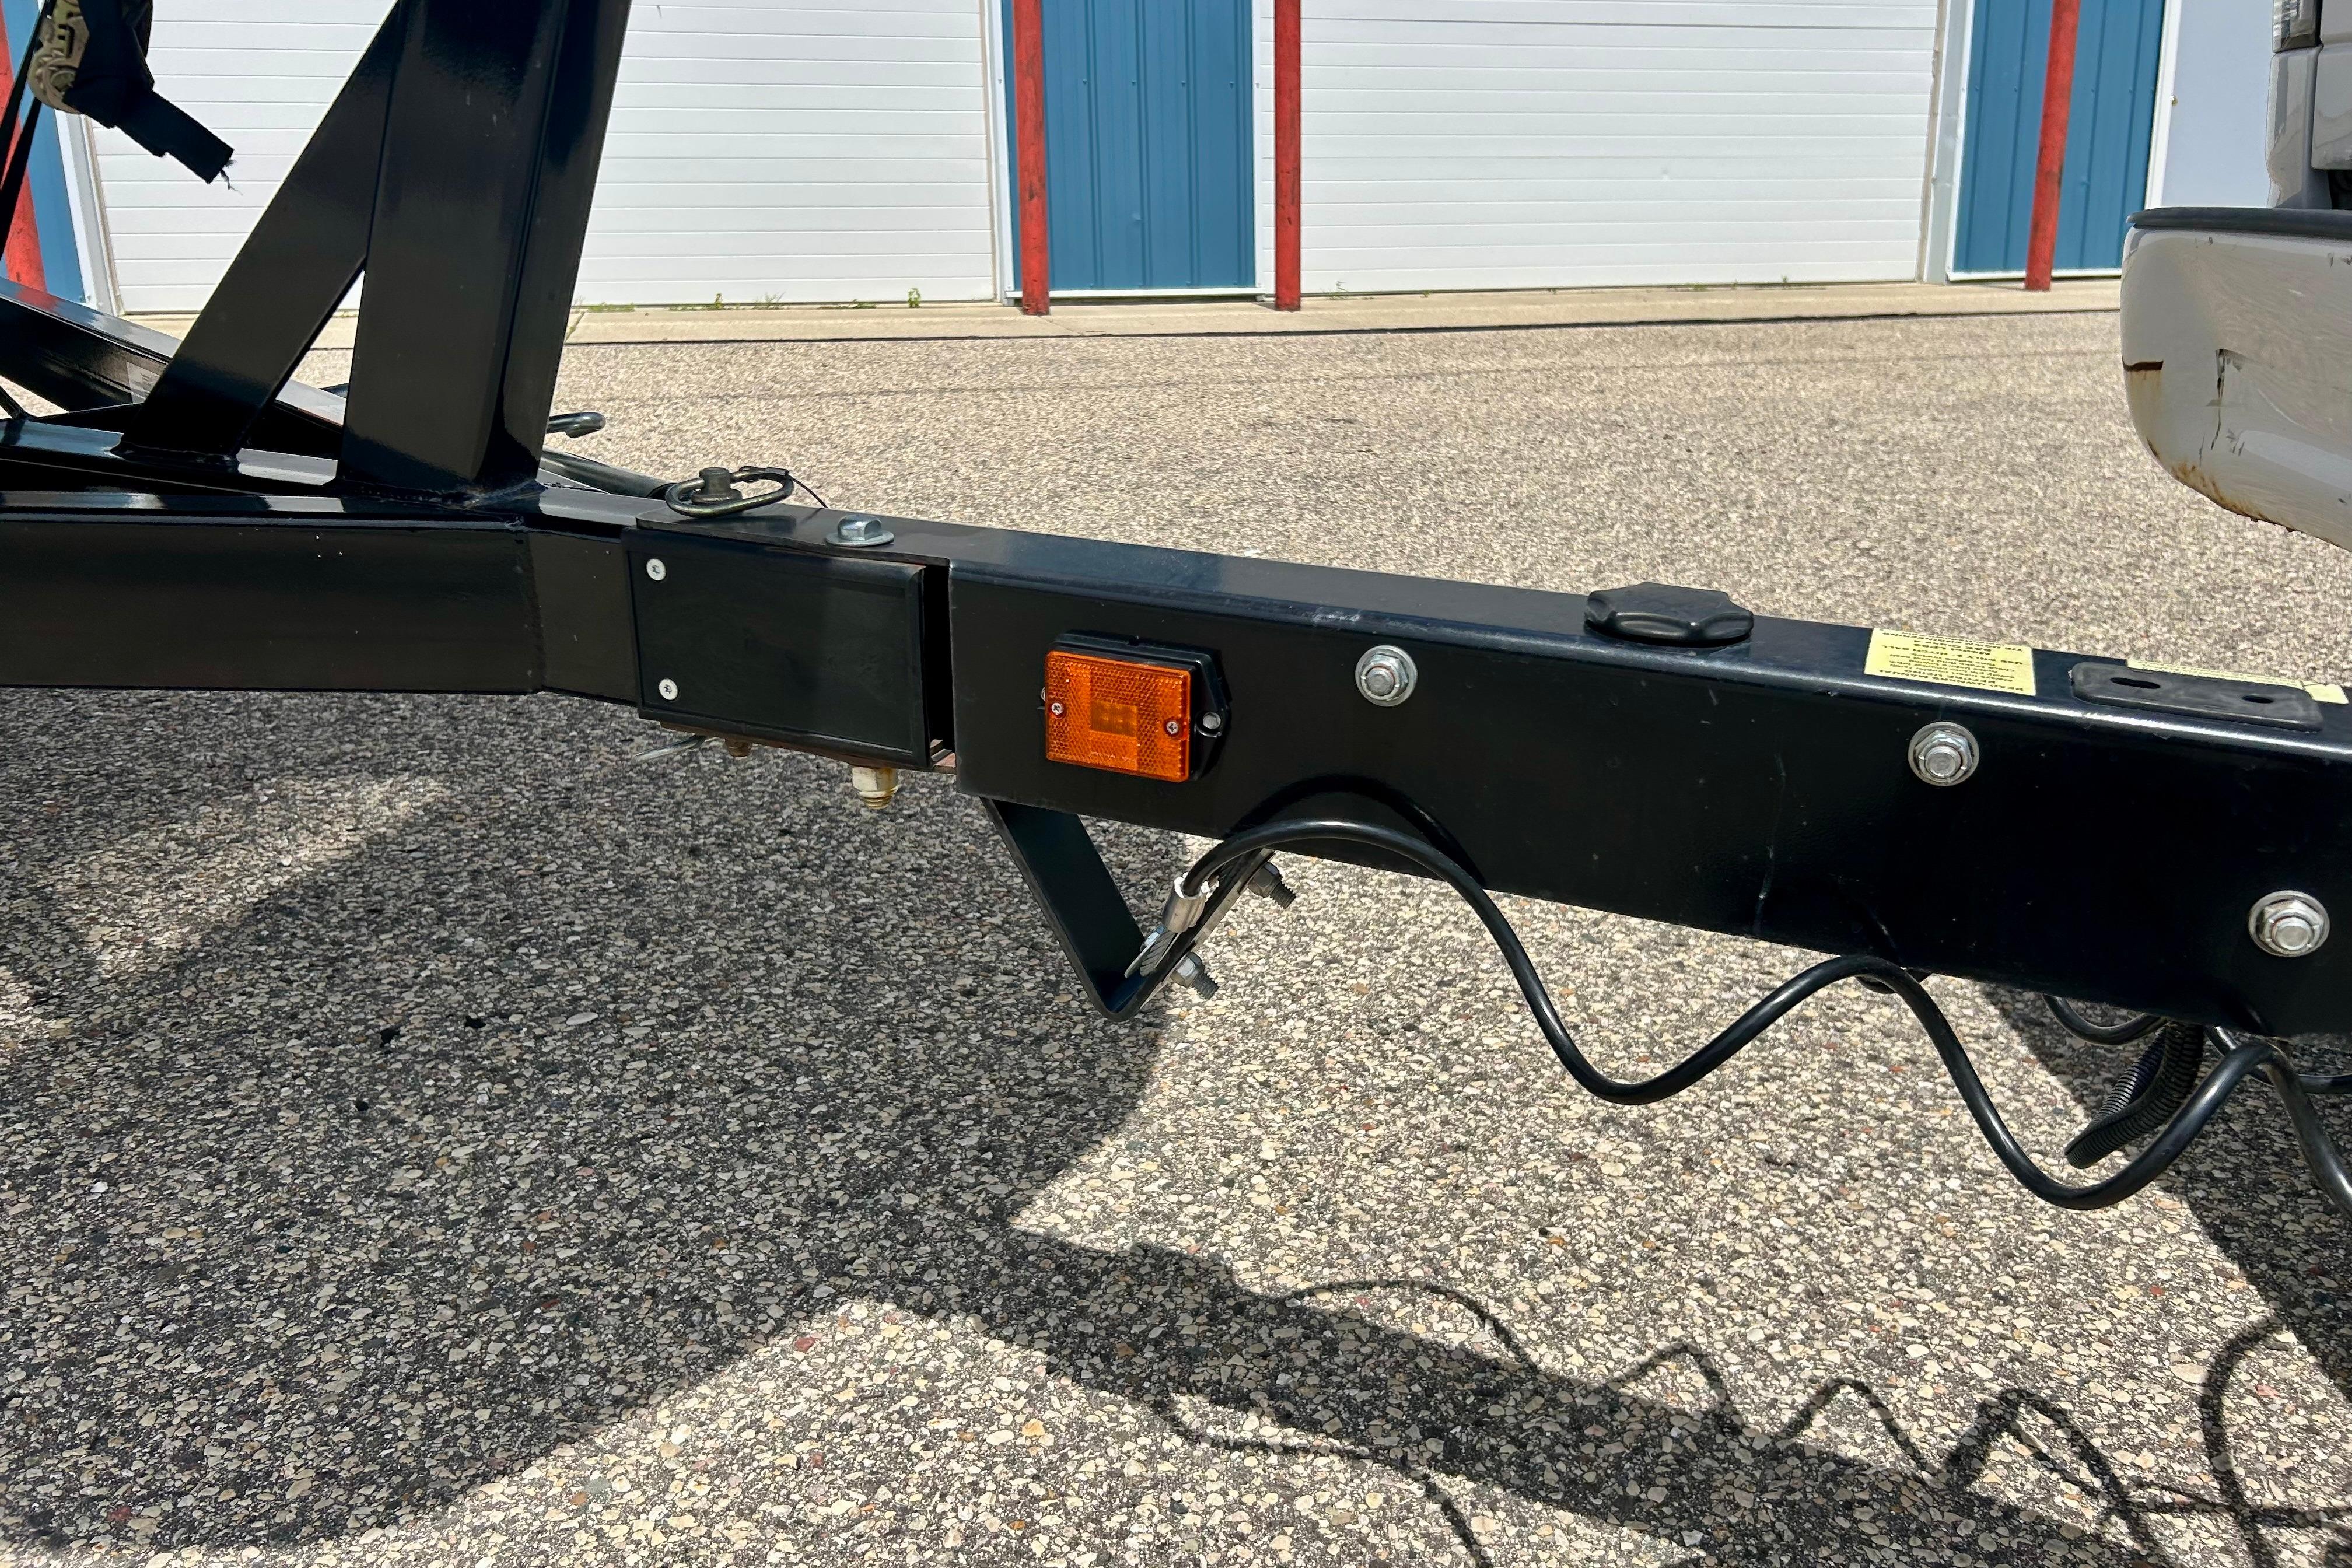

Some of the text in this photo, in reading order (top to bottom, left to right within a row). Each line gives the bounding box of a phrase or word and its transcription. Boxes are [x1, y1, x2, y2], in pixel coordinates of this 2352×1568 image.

[1882, 632, 1961, 644] ENGINEERING
[1876, 669, 1927, 678] MANUAL
[1932, 676, 1985, 685] OWNERS
[1947, 675, 1995, 683] BEFORE
